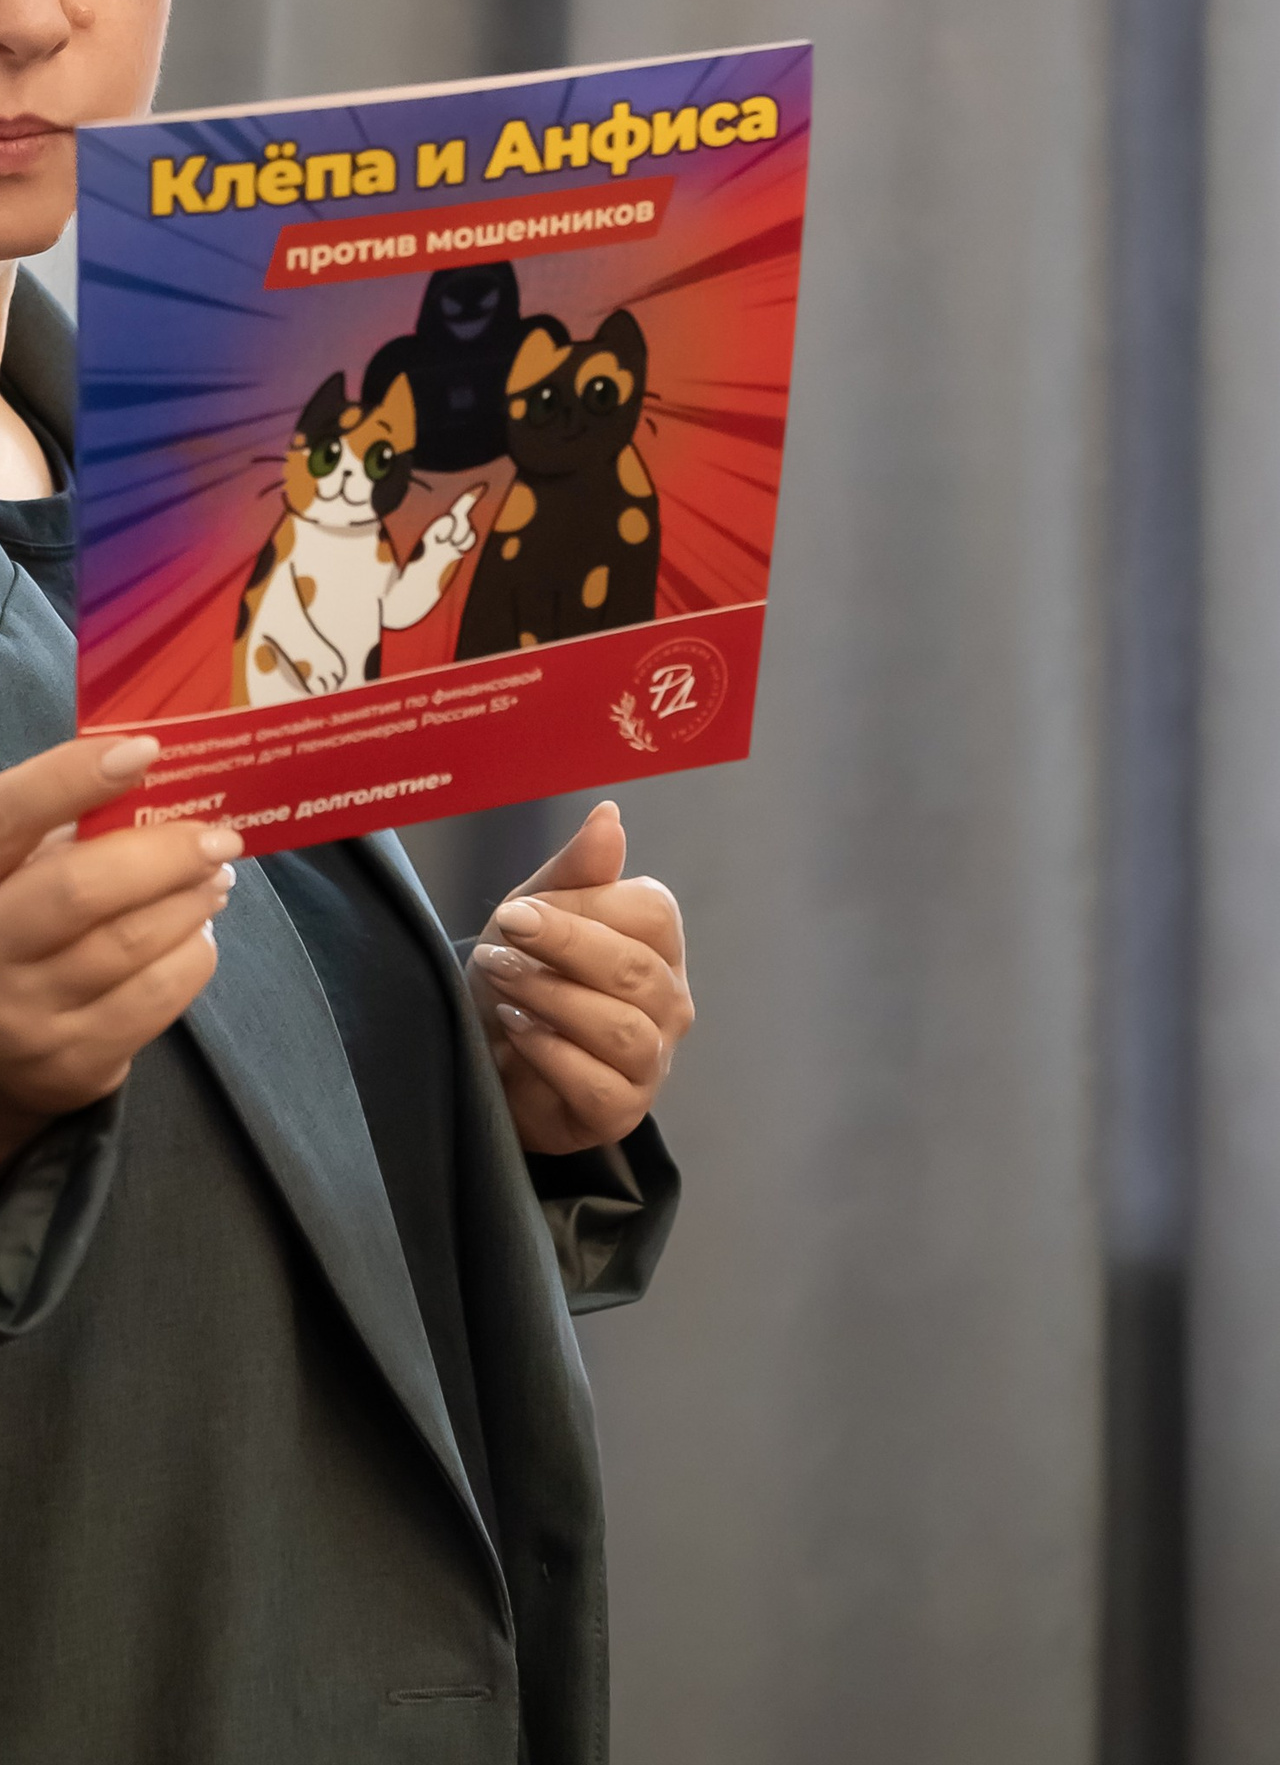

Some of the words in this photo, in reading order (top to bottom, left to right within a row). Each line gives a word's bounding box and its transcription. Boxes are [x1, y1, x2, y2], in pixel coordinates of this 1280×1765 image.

[150, 142, 396, 216] Клёпа
[417, 140, 466, 188] и
[485, 95, 779, 178] Анфиса
[286, 232, 417, 274] против
[426, 199, 656, 255] мошенников
[145, 753, 255, 790] рамотности
[256, 745, 293, 765] для
[296, 718, 417, 754] пенсионеров
[421, 703, 486, 727] России
[160, 733, 252, 761] сплатные
[405, 694, 429, 710] по
[431, 668, 542, 705] финансовой
[134, 792, 227, 827] Проект
[295, 773, 453, 821] долголетие»
